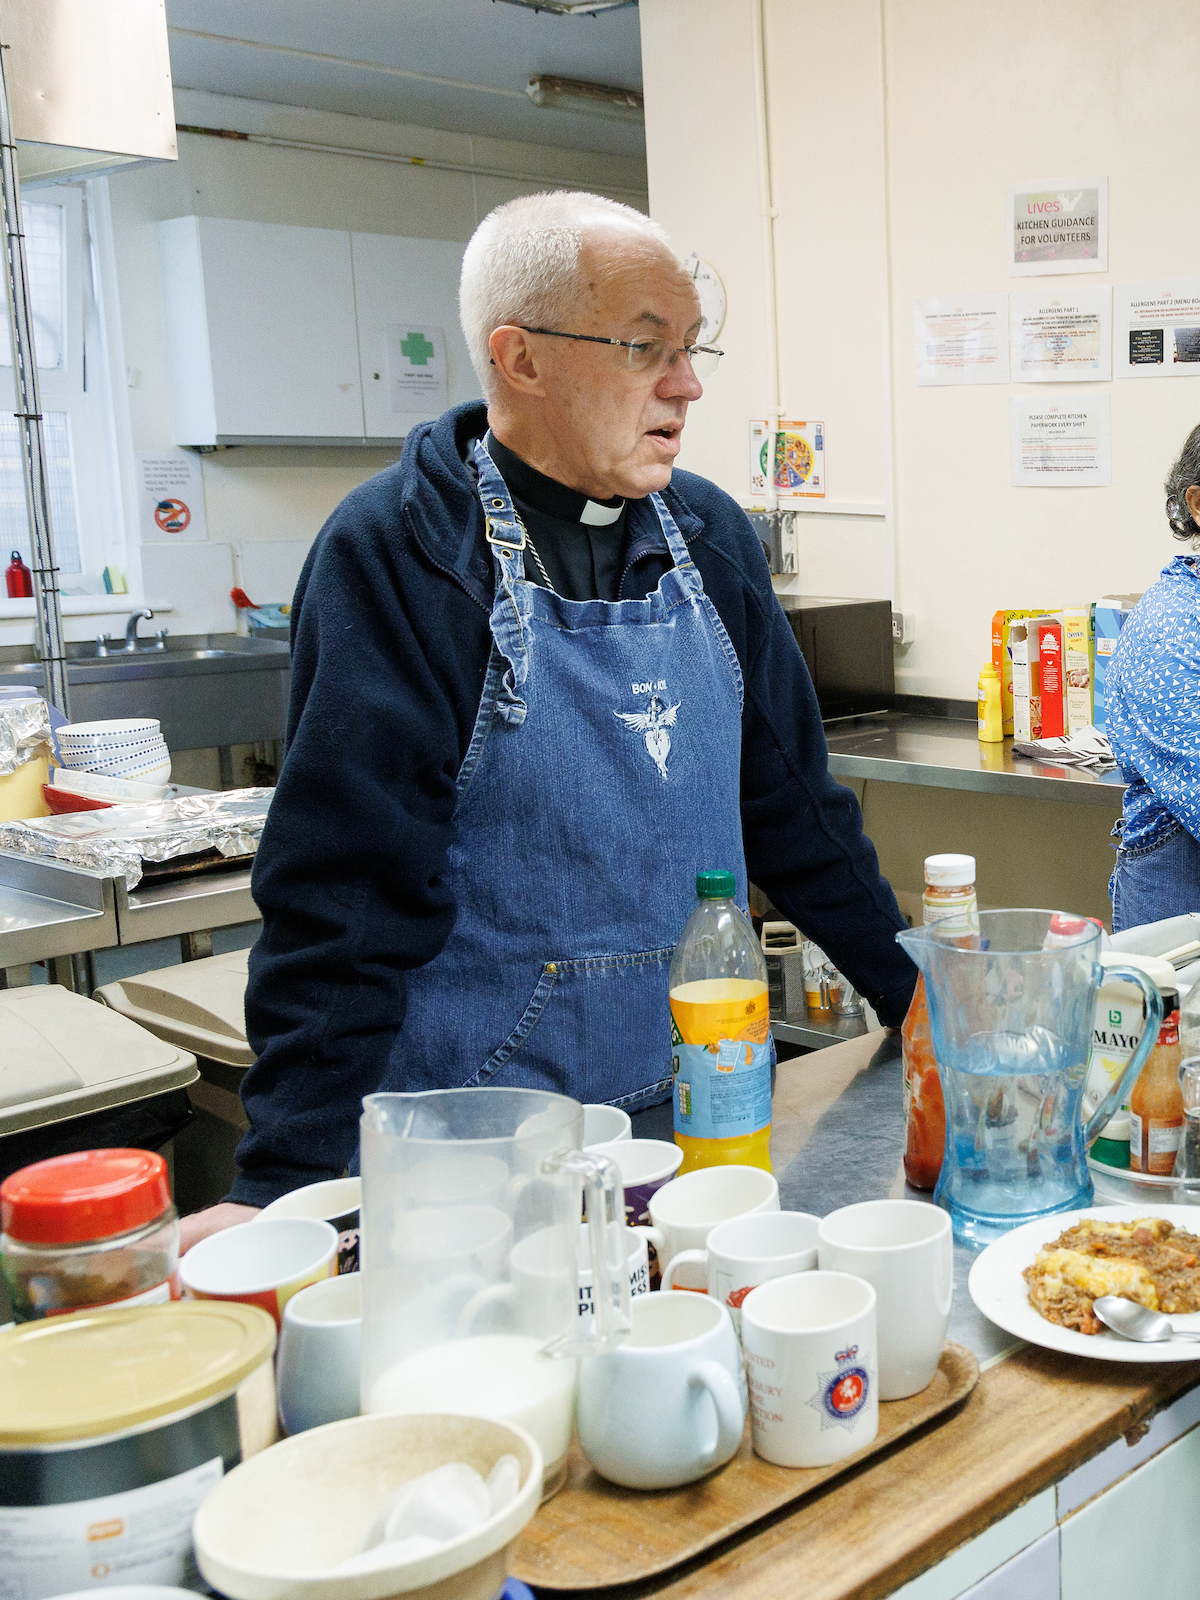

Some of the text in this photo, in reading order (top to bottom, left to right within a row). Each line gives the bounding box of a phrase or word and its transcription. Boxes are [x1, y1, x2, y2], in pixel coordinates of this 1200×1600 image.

[1017, 217, 1094, 230] KITCHEN GUIDANCE
[1021, 232, 1091, 245] FOR VOLUNTEERS
[632, 683, 652, 694] BON
[1093, 1030, 1139, 1050] MAYO
